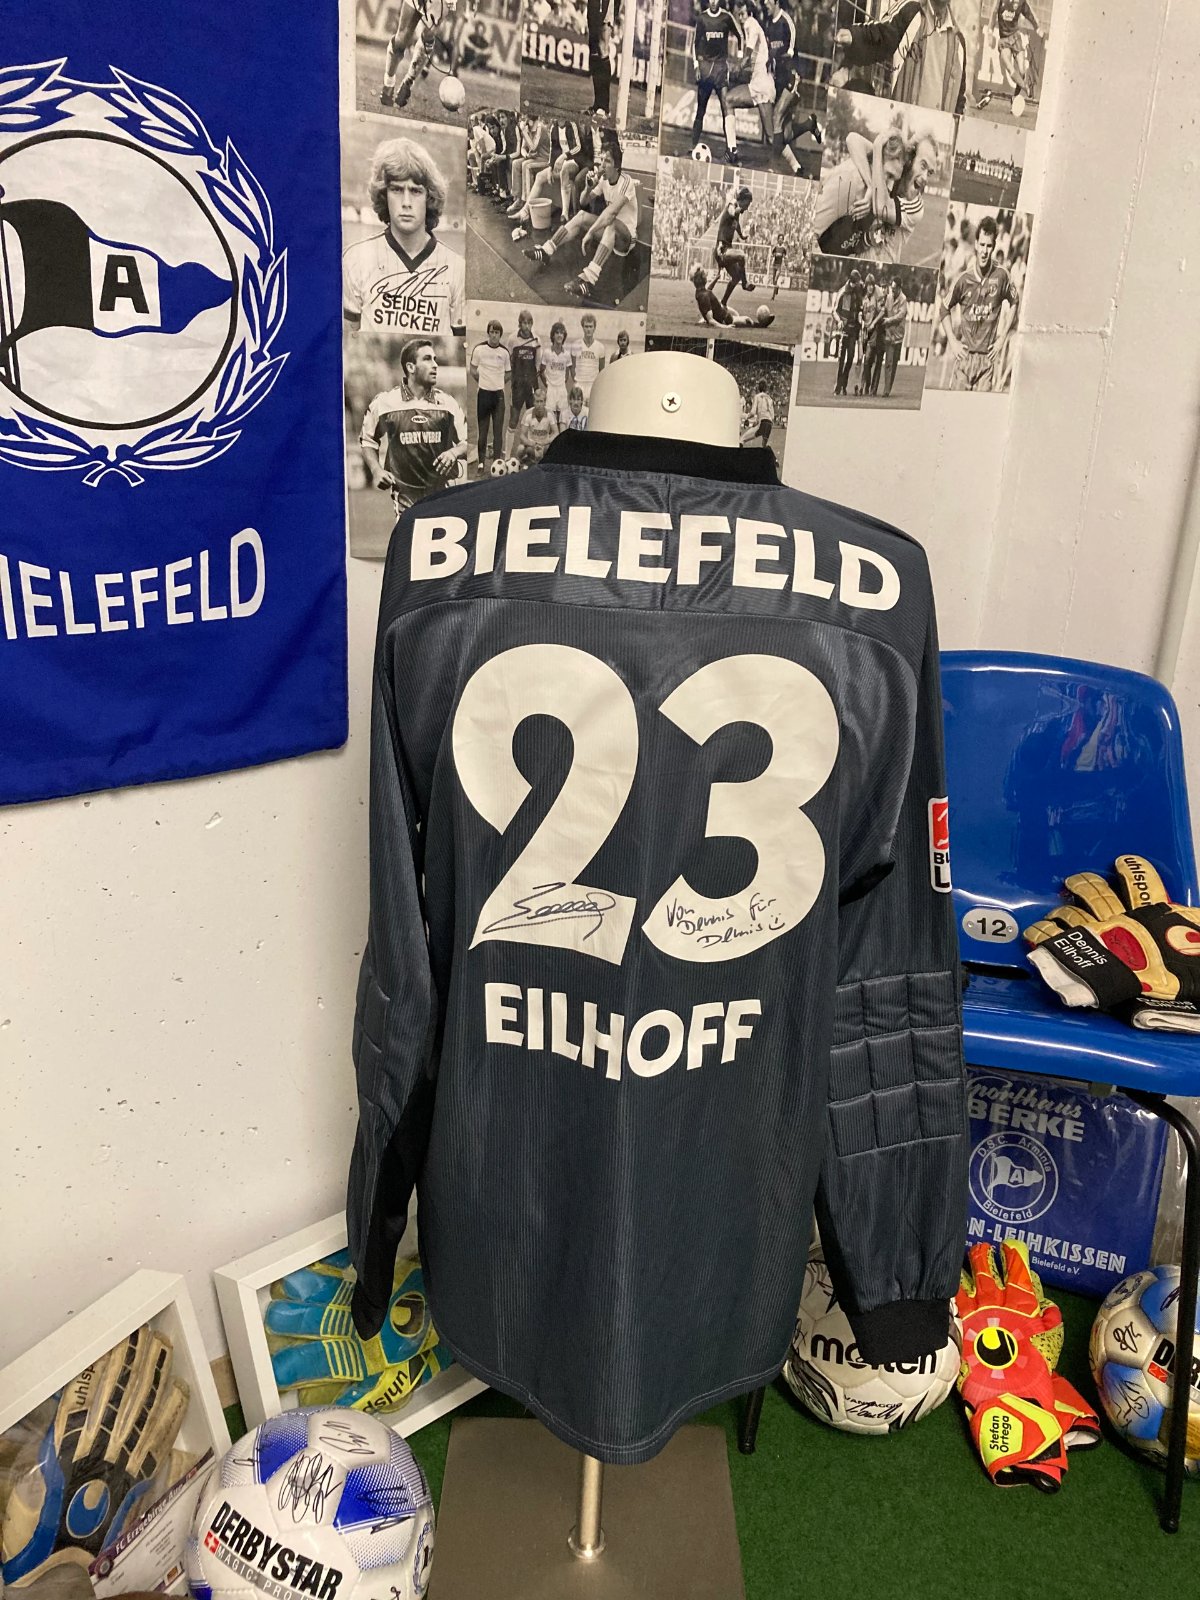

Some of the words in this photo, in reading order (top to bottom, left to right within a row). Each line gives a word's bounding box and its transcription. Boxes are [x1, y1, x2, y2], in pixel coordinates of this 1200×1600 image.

[99, 254, 150, 314] A
[373, 308, 440, 333] STICKER
[382, 291, 438, 317] SEIDEN
[400, 431, 421, 445] GERRY
[409, 505, 901, 611] BIELEFELD
[452, 643, 840, 965] 23
[666, 897, 695, 927] Von
[677, 907, 734, 936] Dennis
[976, 917, 1007, 937] 12
[696, 923, 763, 949] Dennis
[1053, 937, 1095, 969] Eilhoff
[1067, 931, 1108, 966] Dennis
[484, 982, 762, 1081] EILHOFF
[967, 1098, 1085, 1142] BERKE
[1018, 1137, 1052, 1172] Arminia
[983, 1199, 1033, 1220] Bielefeld
[966, 1217, 1126, 1274] N-LEIHKISSEN
[1031, 1256, 1066, 1272] Bielefeld
[989, 1415, 1000, 1451] Stefan
[1000, 1415, 1012, 1453] Ortega
[115, 1540, 125, 1554] FC
[210, 1501, 344, 1600] DERBYSTAR
[216, 1546, 253, 1581] MAGIC
